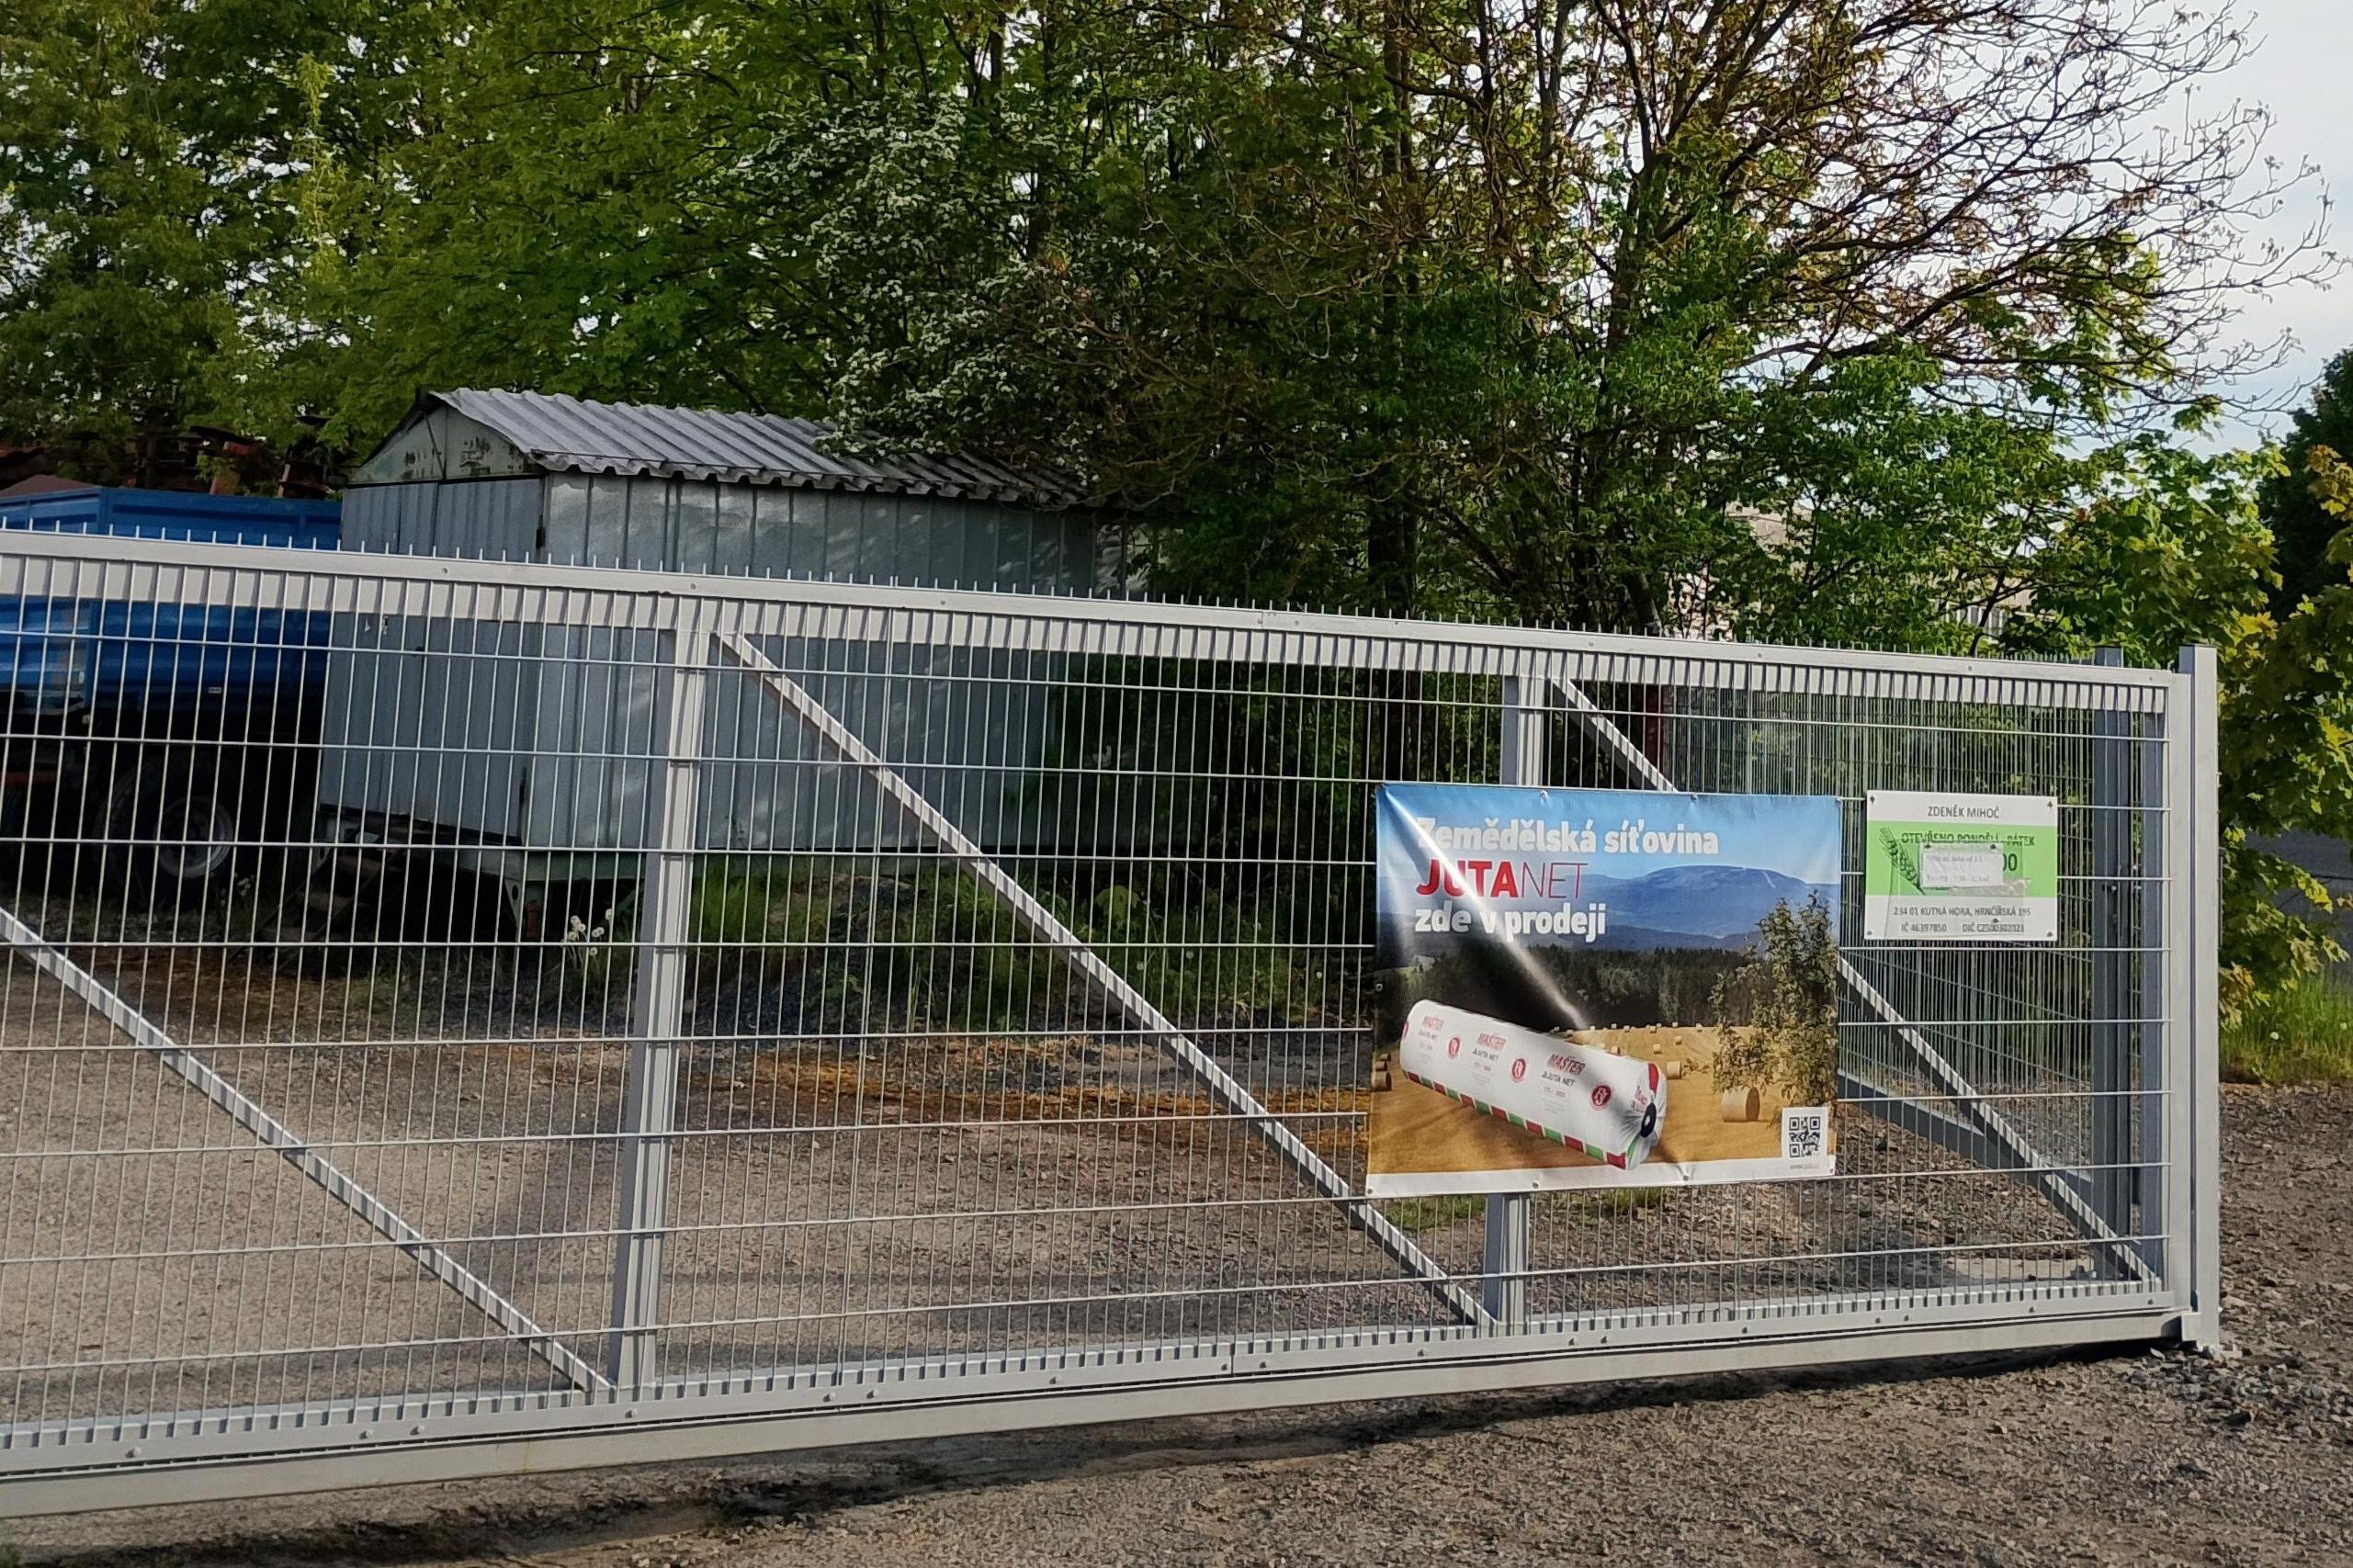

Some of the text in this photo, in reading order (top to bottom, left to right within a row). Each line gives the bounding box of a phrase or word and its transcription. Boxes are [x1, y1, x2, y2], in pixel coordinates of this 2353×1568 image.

[1927, 804, 1999, 818] ZDENĚK MIHOČ
[1416, 817, 1719, 854] Zemědělská síťovina
[1415, 900, 1607, 942] zde v prodeji
